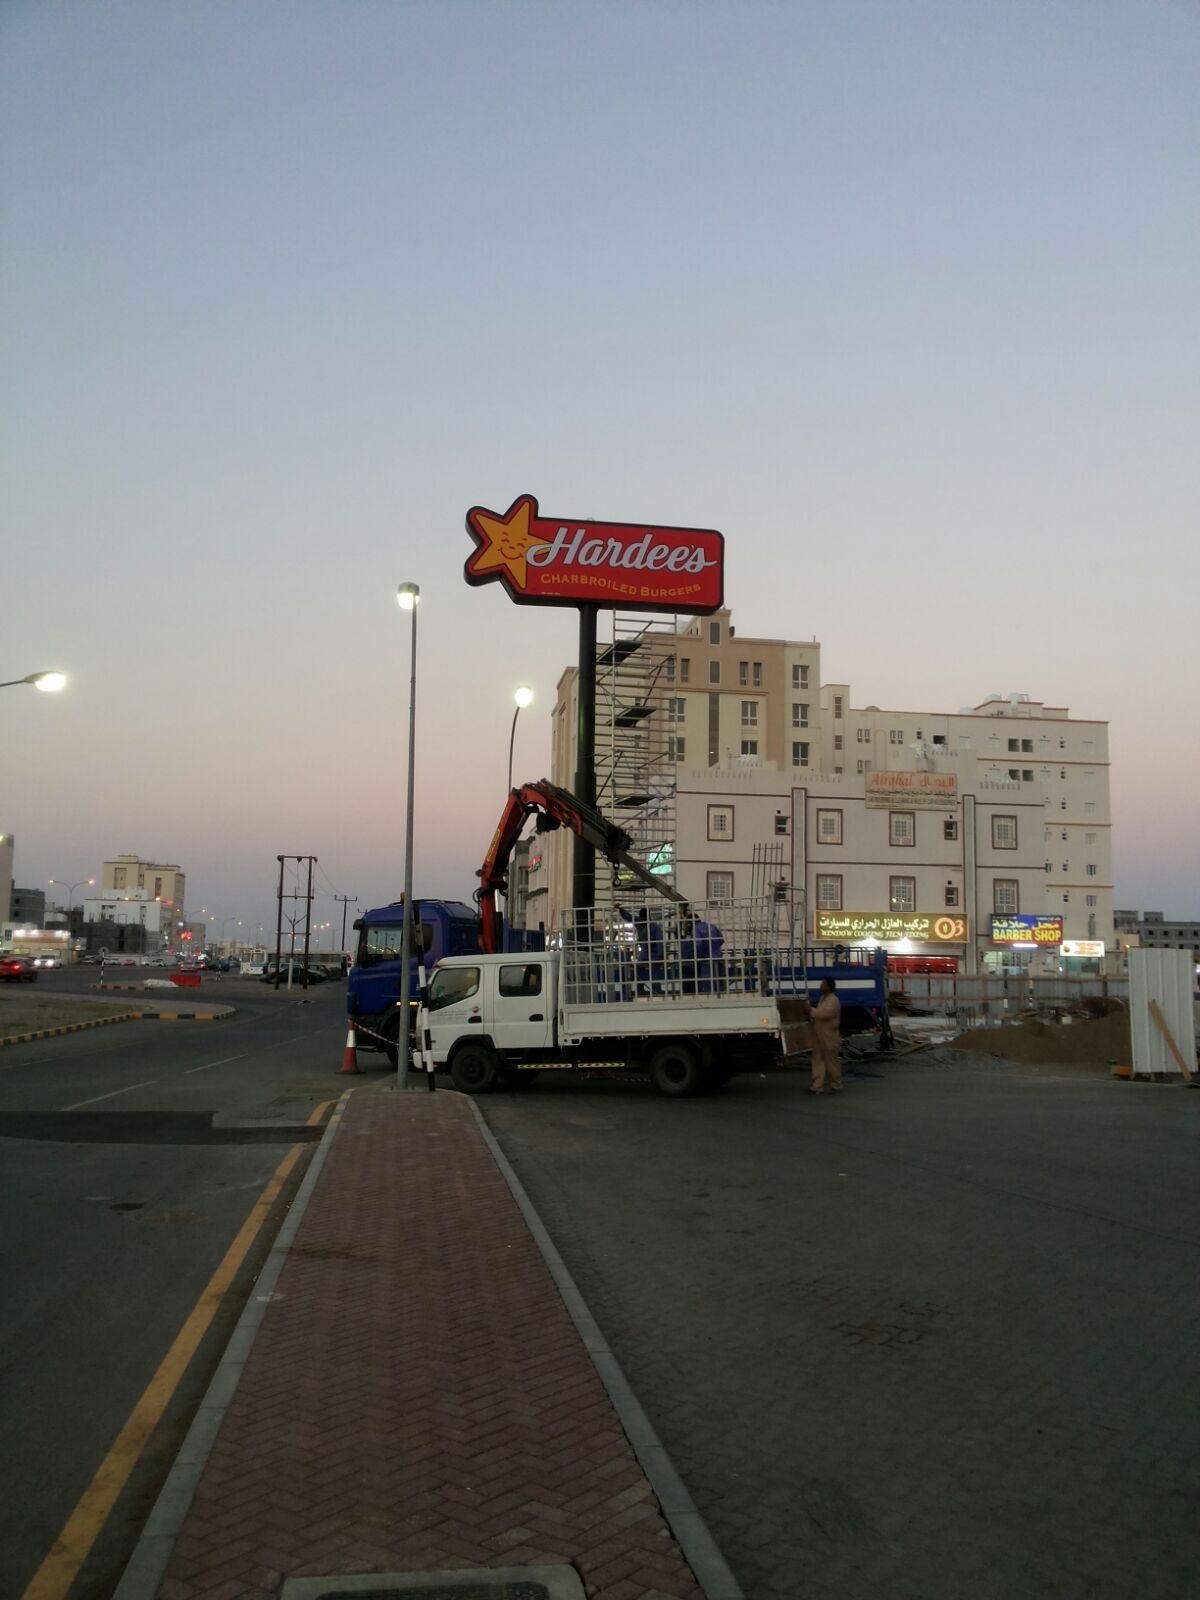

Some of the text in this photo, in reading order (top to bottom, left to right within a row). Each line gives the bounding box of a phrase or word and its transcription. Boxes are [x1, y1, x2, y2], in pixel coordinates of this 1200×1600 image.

[526, 527, 718, 573] Hardee's
[540, 573, 701, 598] CHARBROILED BURGERS
[992, 919, 1029, 928] حلاقة
[992, 928, 1062, 942] BARBER SHOP
